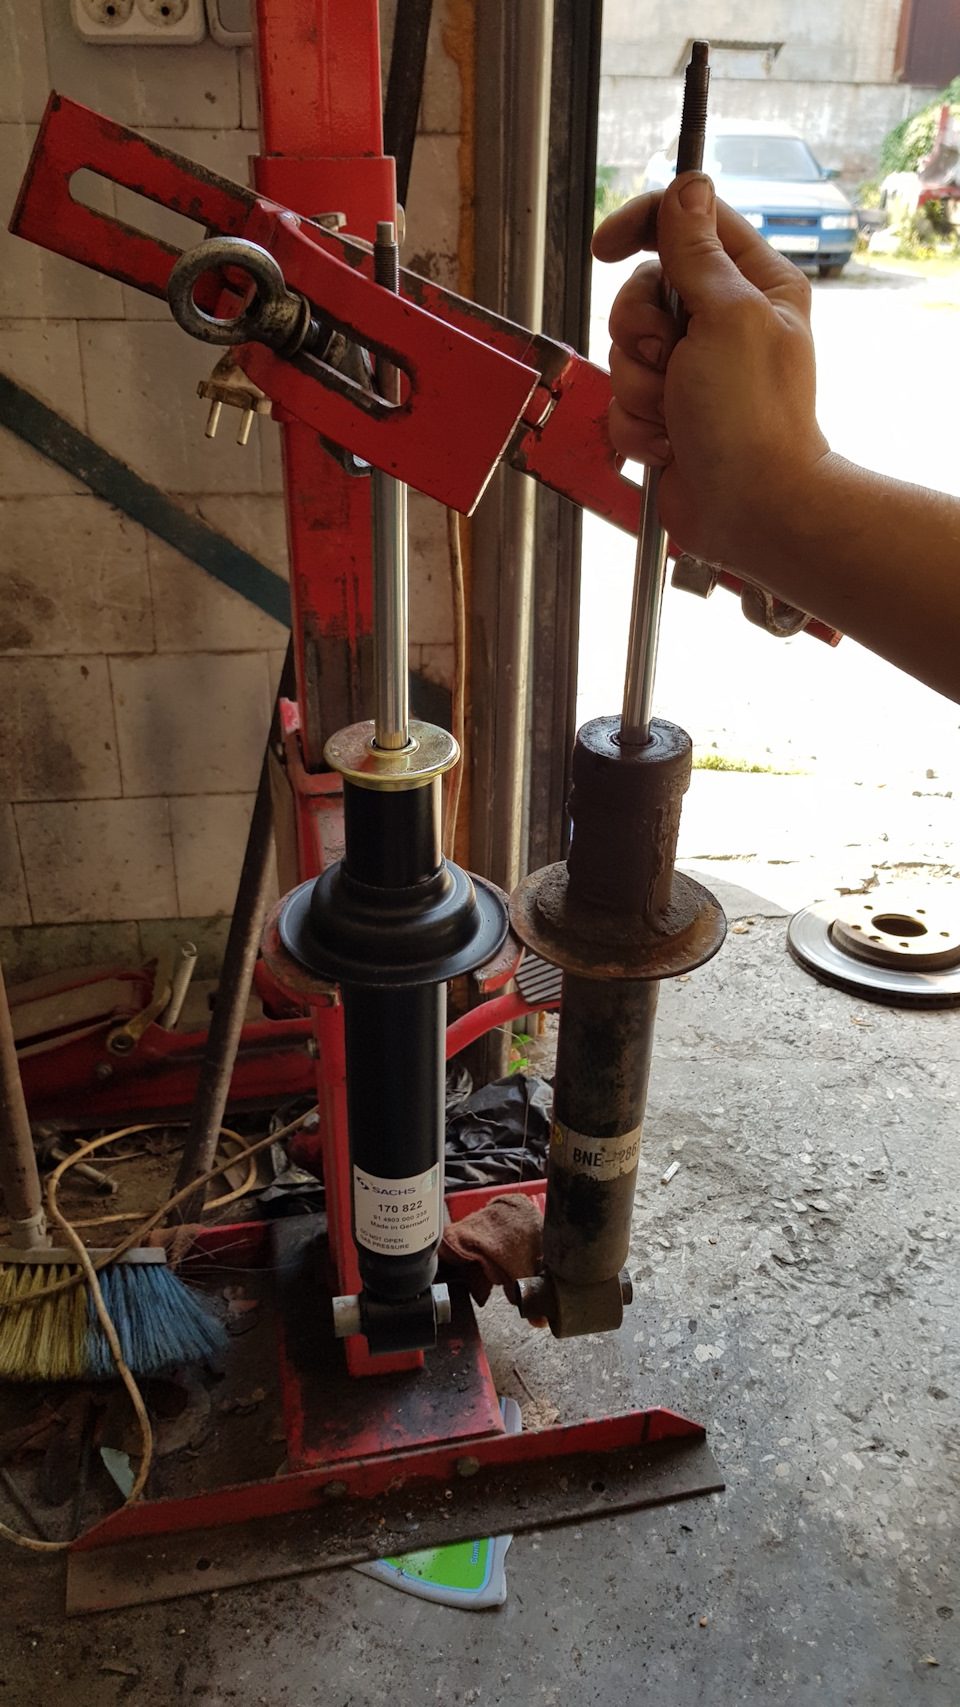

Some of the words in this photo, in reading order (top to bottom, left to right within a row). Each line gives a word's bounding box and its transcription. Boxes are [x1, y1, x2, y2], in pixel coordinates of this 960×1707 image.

[372, 1186, 417, 1196] SACHS
[378, 1204, 398, 1213] 170
[402, 1200, 423, 1213] 822
[370, 1220, 389, 1230] Made
[399, 1216, 430, 1230] Germany
[369, 1233, 382, 1242] NOT
[372, 1241, 410, 1250] PRESSURE
